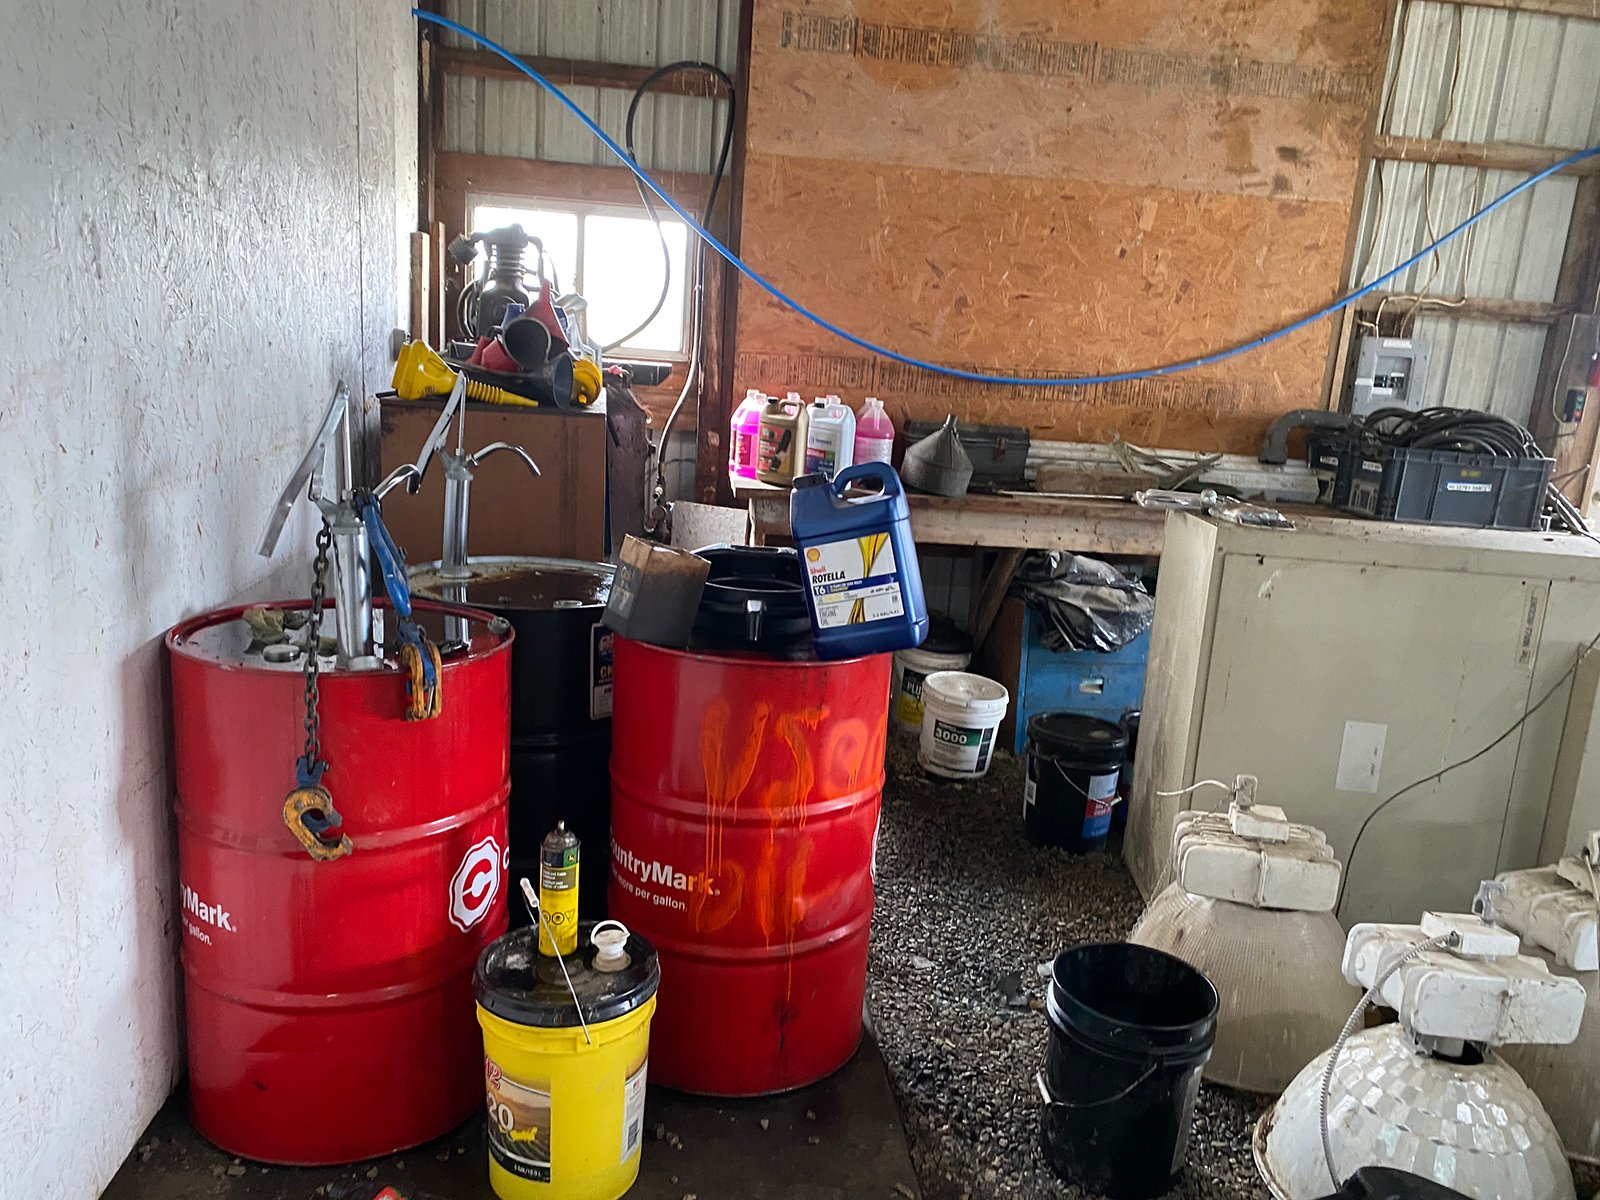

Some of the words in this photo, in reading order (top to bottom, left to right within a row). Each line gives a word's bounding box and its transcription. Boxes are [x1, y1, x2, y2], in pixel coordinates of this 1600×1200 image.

[810, 566, 826, 575] Shell
[812, 571, 846, 584] ROTELLA
[814, 586, 826, 595] T6
[907, 681, 922, 695] PLU
[935, 727, 968, 744] 3000
[618, 875, 634, 893] more
[635, 886, 651, 900] per
[653, 894, 688, 912] gallon.
